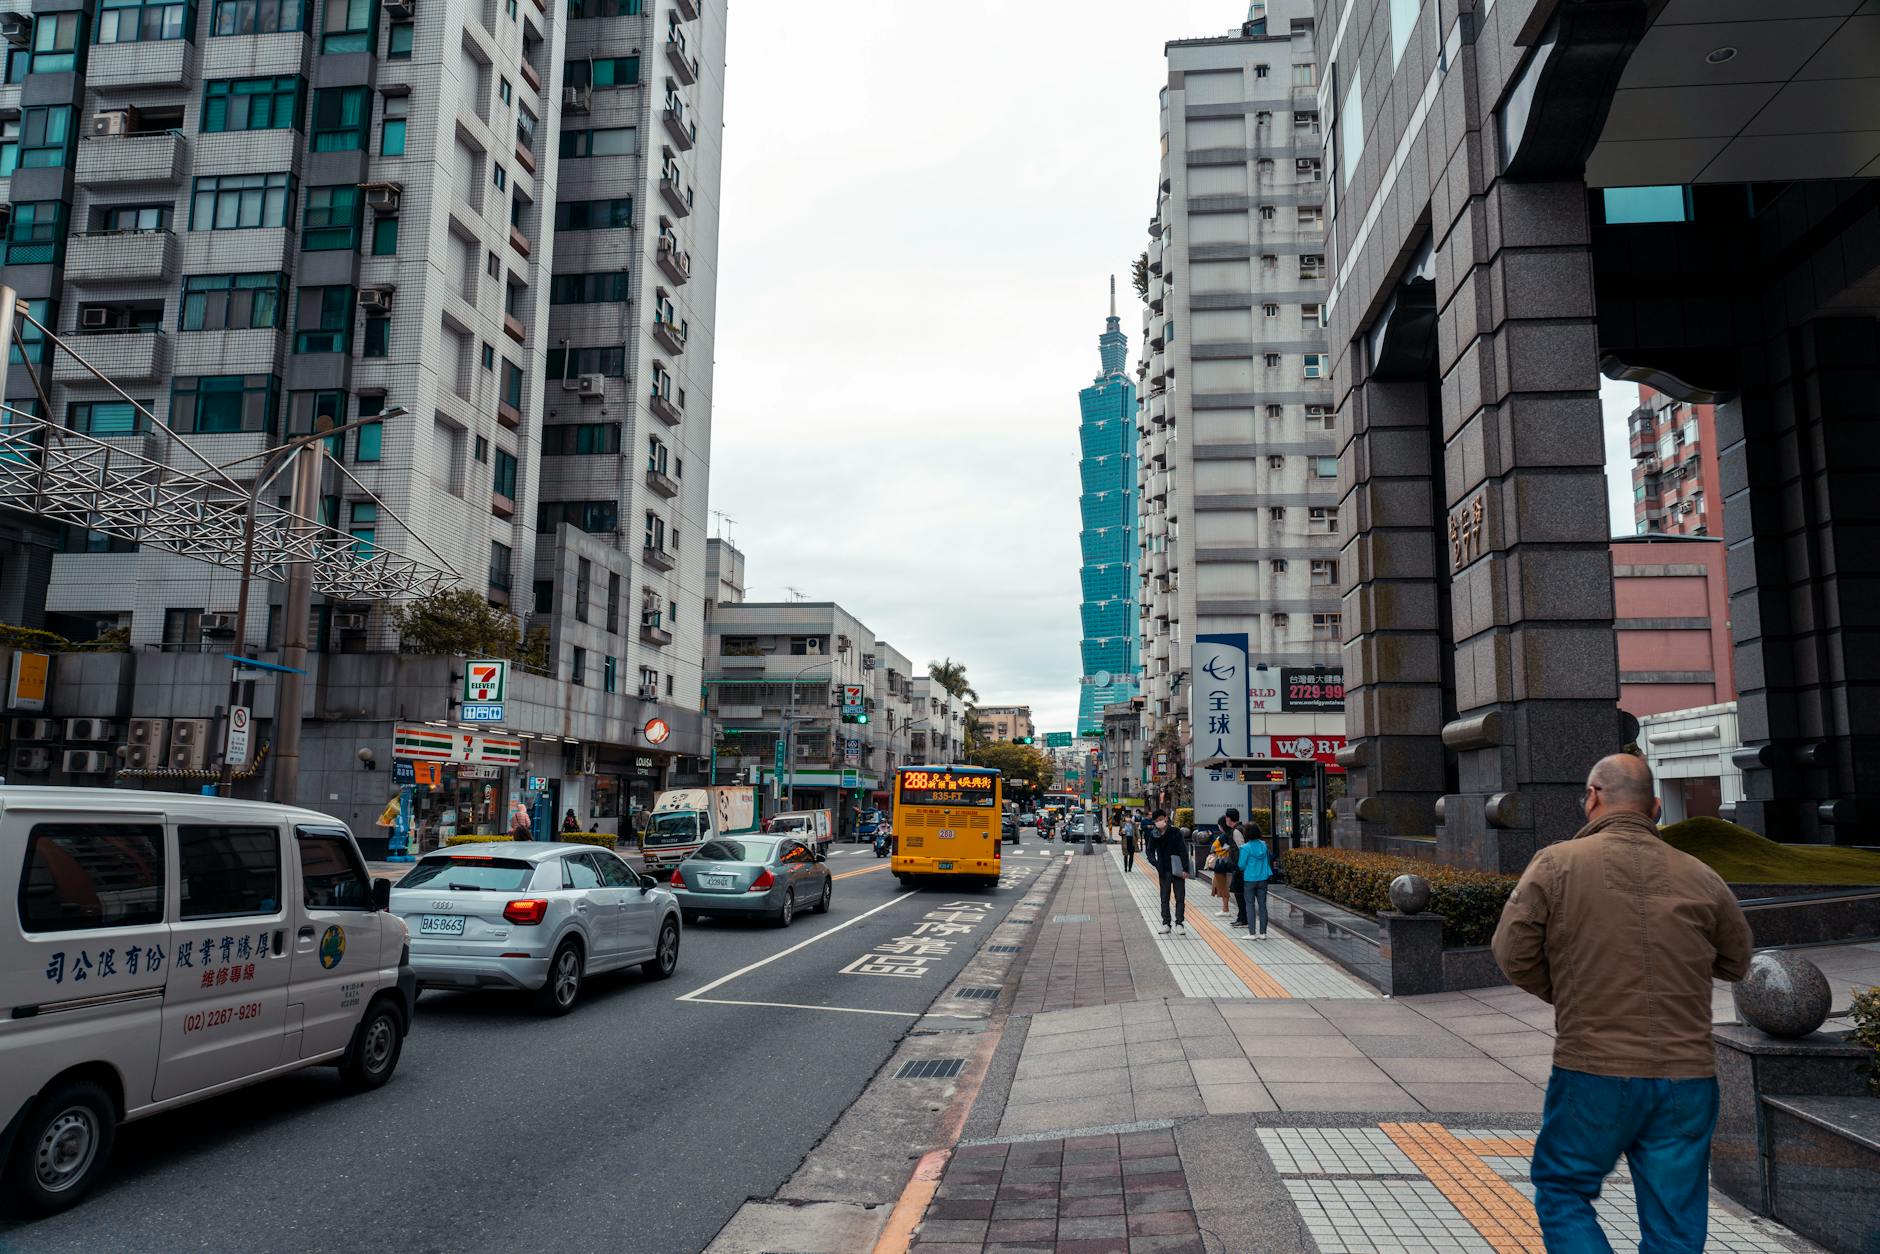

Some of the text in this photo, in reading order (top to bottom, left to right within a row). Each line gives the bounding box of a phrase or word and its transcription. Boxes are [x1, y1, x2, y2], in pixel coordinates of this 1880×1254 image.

[473, 667, 497, 699] 7
[1249, 688, 1276, 697] RLD
[636, 756, 652, 767] LOUISA
[905, 772, 928, 789] 288
[932, 791, 963, 800] 835-FT
[422, 918, 463, 931] BAS-8663
[201, 963, 255, 988] 維修專線
[183, 1013, 205, 1035] (02)
